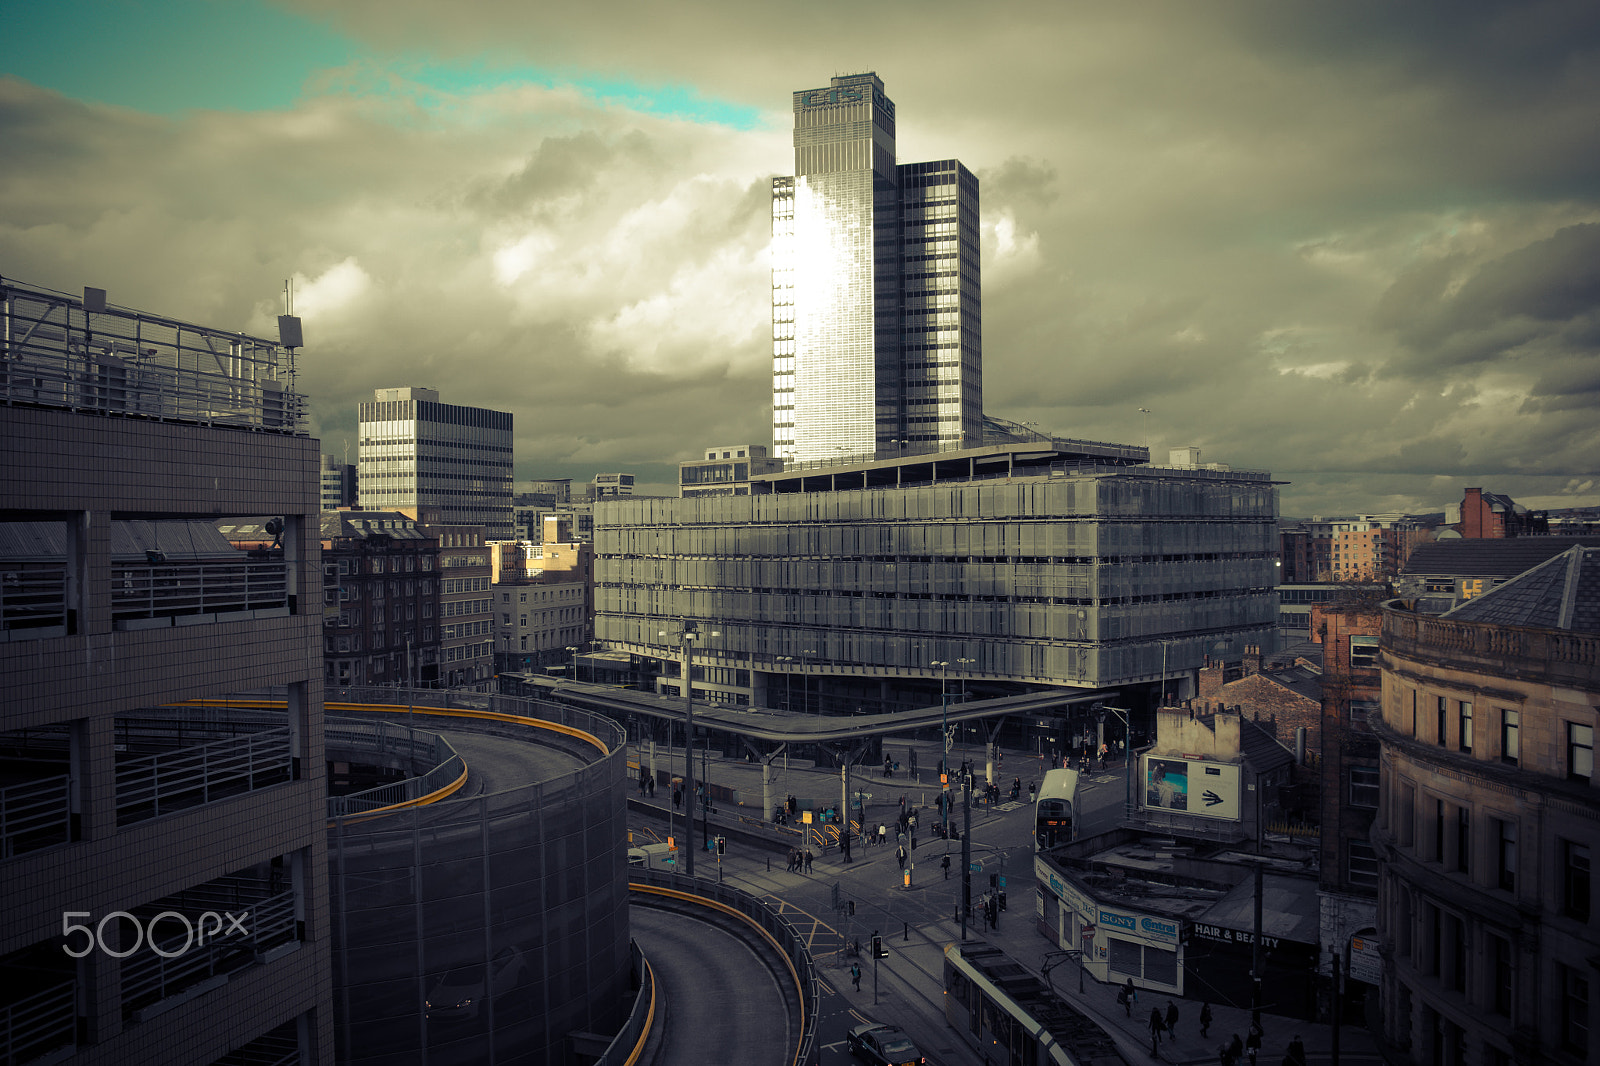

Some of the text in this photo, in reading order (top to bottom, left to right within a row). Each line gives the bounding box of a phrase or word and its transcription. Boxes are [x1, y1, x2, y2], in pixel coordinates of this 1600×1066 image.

[1101, 914, 1134, 927] SONY
[1141, 917, 1176, 935] Central
[1194, 923, 1221, 937] HAIR
[1223, 928, 1232, 940] &
